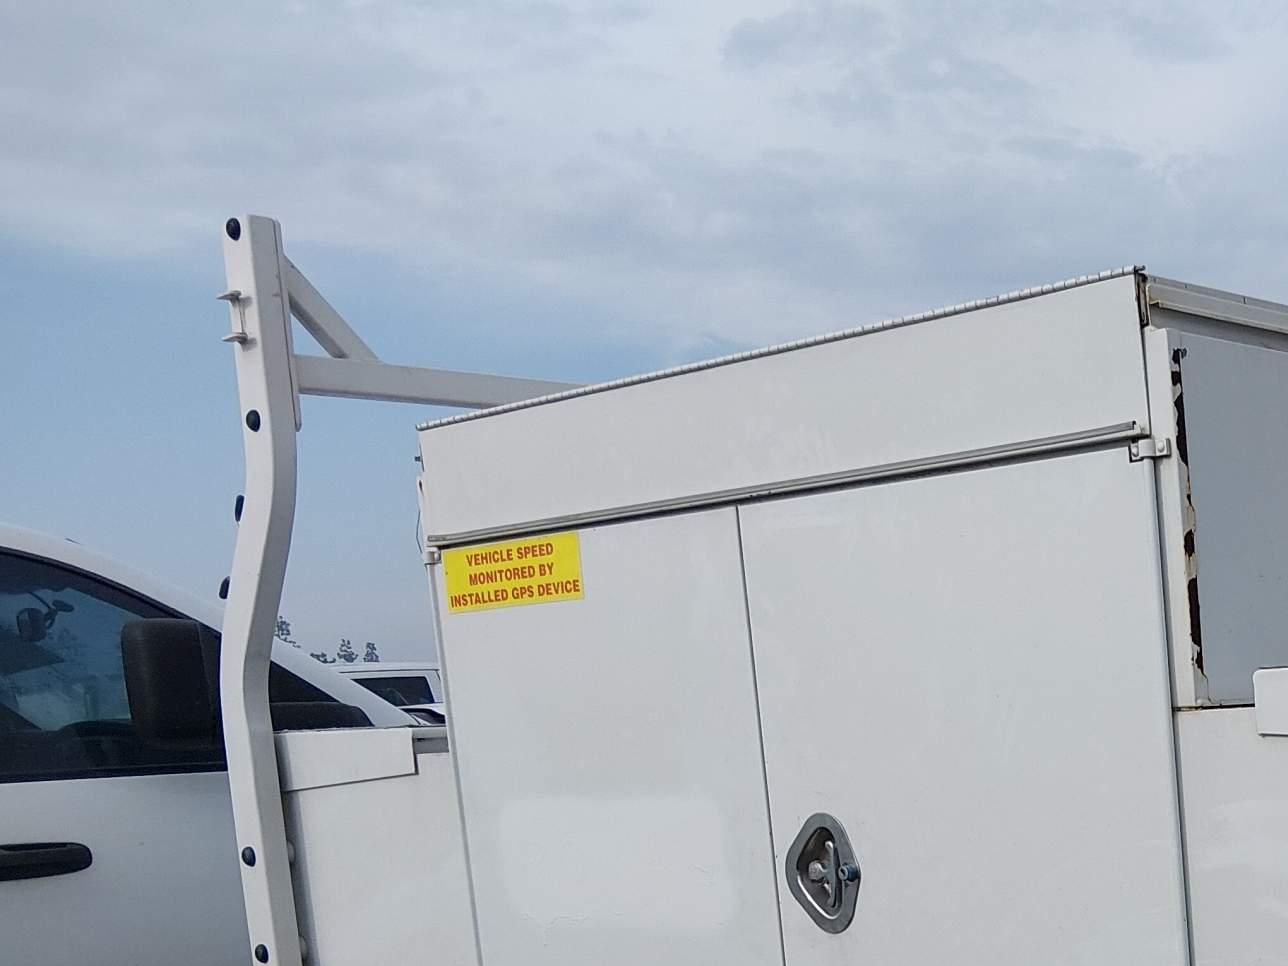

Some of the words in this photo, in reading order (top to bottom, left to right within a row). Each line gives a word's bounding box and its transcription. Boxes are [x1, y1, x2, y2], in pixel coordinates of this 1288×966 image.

[466, 549, 513, 566] VEHICLE
[517, 543, 554, 560] SPEED
[469, 565, 535, 586] MONITORED
[539, 562, 554, 577] BY
[450, 589, 508, 607] INSTALLED
[512, 585, 534, 600] GPS
[538, 579, 580, 596] DEVICE
